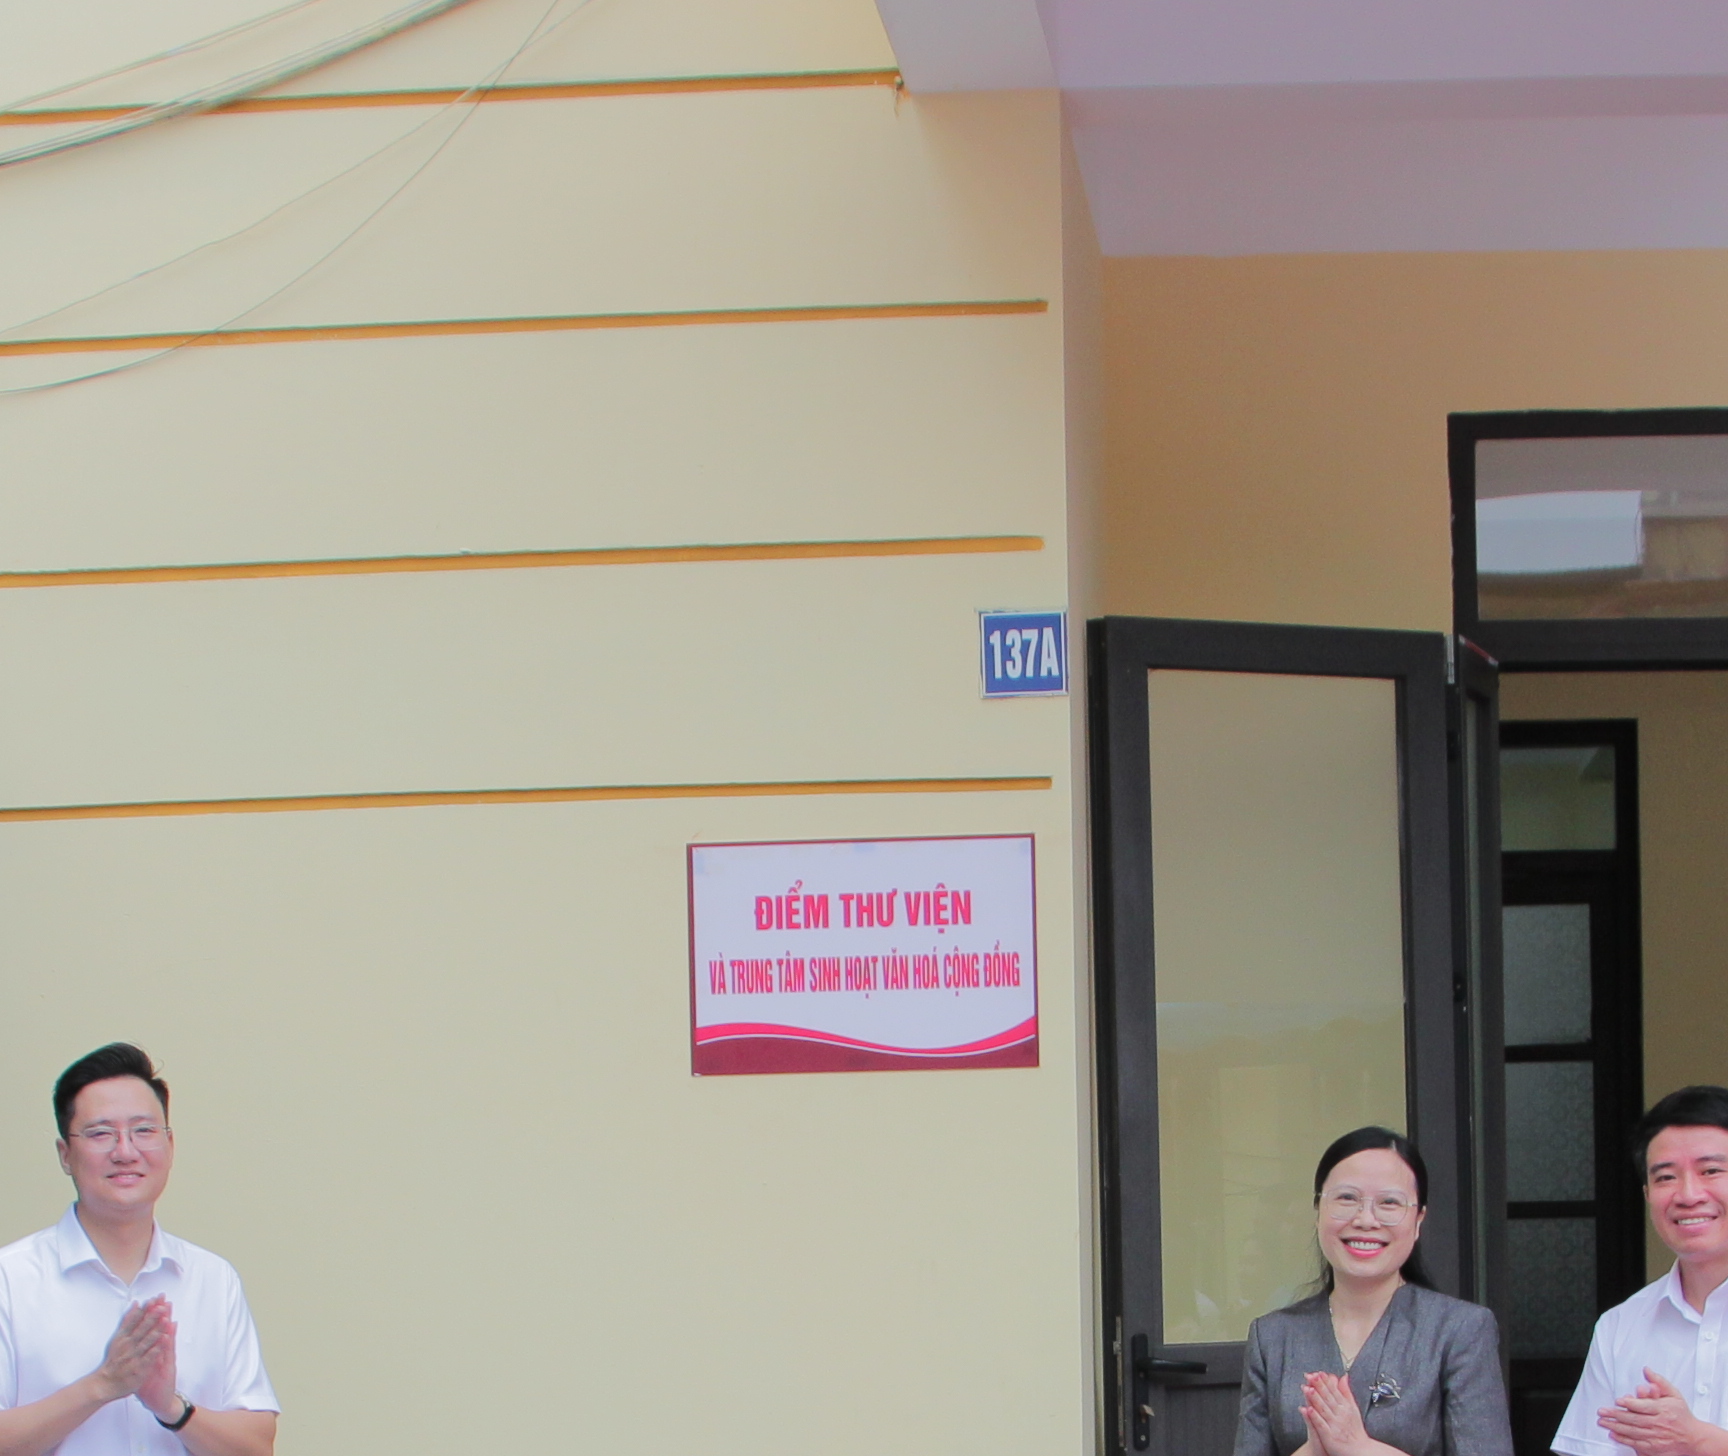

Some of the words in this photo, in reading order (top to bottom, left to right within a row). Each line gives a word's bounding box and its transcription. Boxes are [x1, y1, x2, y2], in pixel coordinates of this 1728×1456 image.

[989, 627, 1060, 679] 137A
[754, 879, 830, 931] ĐIỂM
[839, 888, 898, 928] THƯ
[904, 883, 972, 934] VIỆN
[709, 952, 727, 995] VÀ
[729, 957, 773, 994] TRUNG
[777, 950, 805, 993] TÂM
[809, 955, 841, 992] SINH
[844, 955, 878, 999] HOẠT
[882, 947, 909, 990] VĂN
[913, 946, 940, 988] HOÁ
[943, 945, 980, 996] CỘNG
[983, 940, 1020, 987] ĐỒNG
